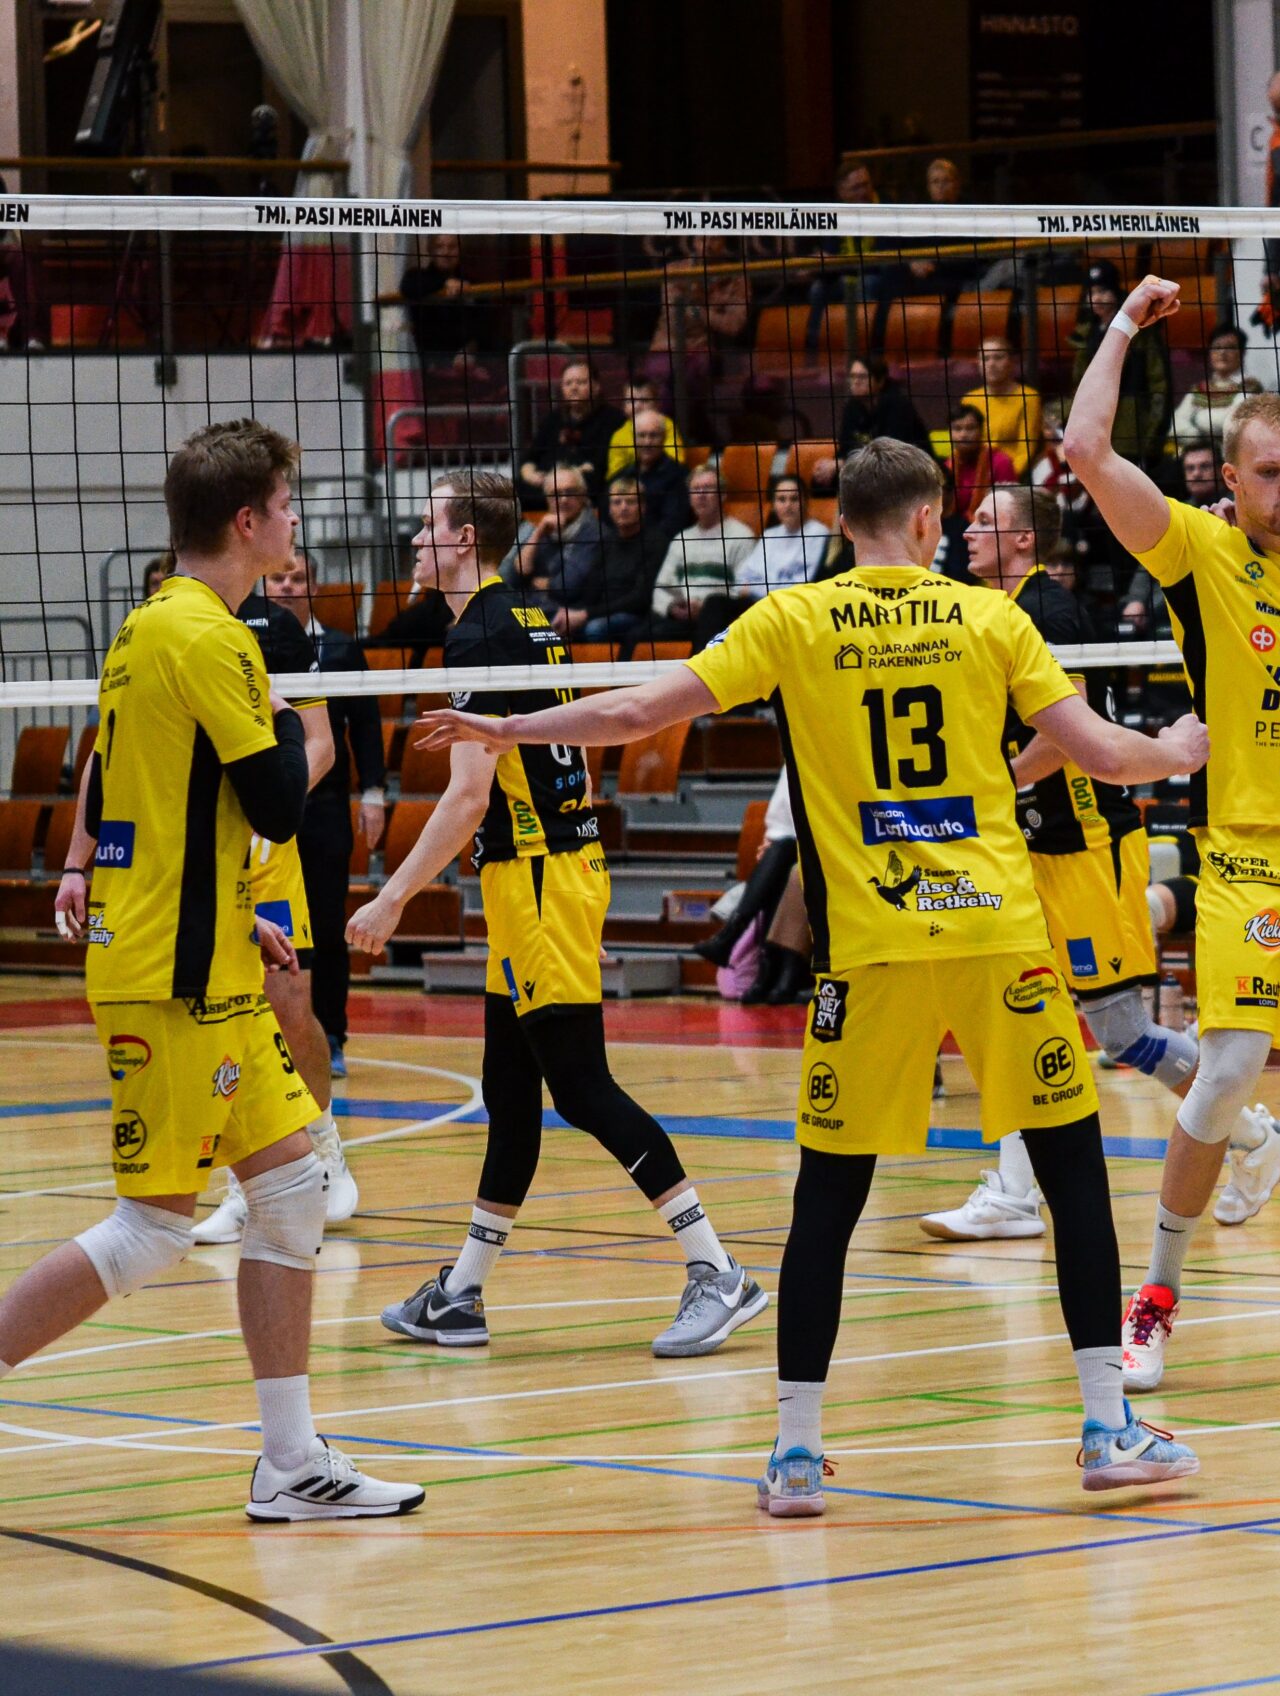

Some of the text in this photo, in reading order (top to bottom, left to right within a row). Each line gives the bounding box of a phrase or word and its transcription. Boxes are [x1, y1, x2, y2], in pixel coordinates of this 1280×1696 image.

[0, 204, 29, 223] EN
[255, 205, 442, 228] TMI. PASI MERILÄINEN
[663, 209, 838, 230] TMI. PASI MERILÄINEN
[1038, 213, 1200, 233] TMI. PASI MERILÄINEN
[830, 599, 964, 633] MARTTILA
[867, 638, 949, 656] OJARANNAN
[867, 650, 963, 670] RAKENNUS OY
[861, 684, 948, 790] 13
[1071, 775, 1093, 811] KPO
[513, 800, 539, 835] KPO
[917, 876, 977, 896] Ase &
[917, 892, 1002, 911] Retkeily
[1238, 980, 1248, 991] K
[819, 998, 841, 1014] NEY
[274, 1032, 294, 1074] 9
[1041, 1043, 1071, 1080] BE
[811, 1074, 833, 1100] BE
[1032, 1083, 1084, 1106] BE GROUP
[115, 1120, 140, 1147] BE
[812, 1116, 844, 1131] GROUP
